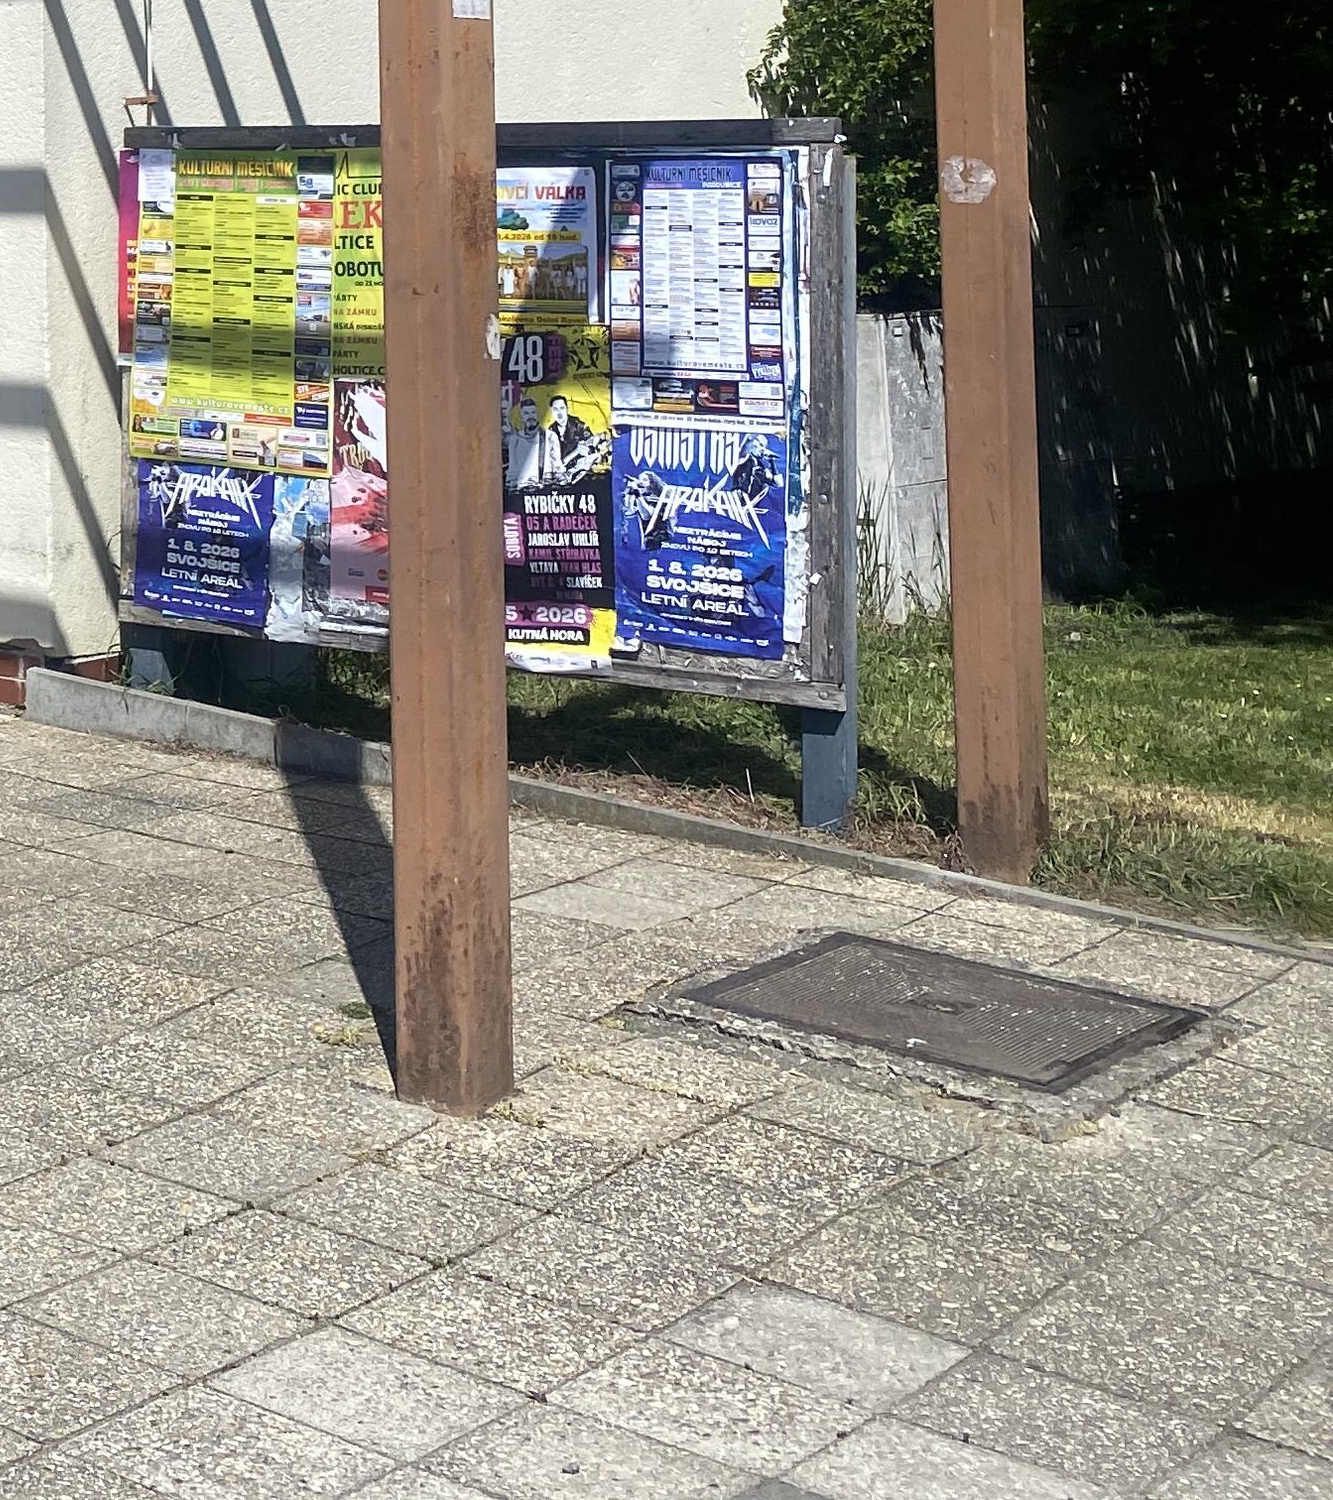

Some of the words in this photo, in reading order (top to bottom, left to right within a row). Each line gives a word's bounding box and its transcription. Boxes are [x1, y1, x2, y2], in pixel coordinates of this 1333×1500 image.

[535, 182, 586, 200] VÁLKA
[335, 201, 383, 228] EK
[509, 336, 543, 382] 48
[524, 491, 575, 514] RYBIČKY
[579, 494, 596, 513] 48
[552, 513, 597, 531] RADEČEK
[503, 517, 521, 558] SOBOTA
[528, 532, 570, 546] JAROSLAV
[201, 543, 240, 559] 2026
[167, 552, 240, 573] SVOJŠICE
[529, 562, 559, 573] VLTAVA
[648, 558, 663, 572] 1.
[669, 561, 686, 575] 8.
[691, 564, 743, 582] 2026
[161, 567, 198, 582] LETNÍ
[201, 573, 243, 589] AREÁL
[646, 574, 745, 599] SVOJŠICE
[641, 592, 687, 608] LETNÍ
[693, 598, 750, 616] AREÁL
[505, 606, 518, 621] 5
[536, 606, 587, 624] 2026
[508, 627, 548, 640] KUTNÁ
[550, 629, 584, 641] HORA
